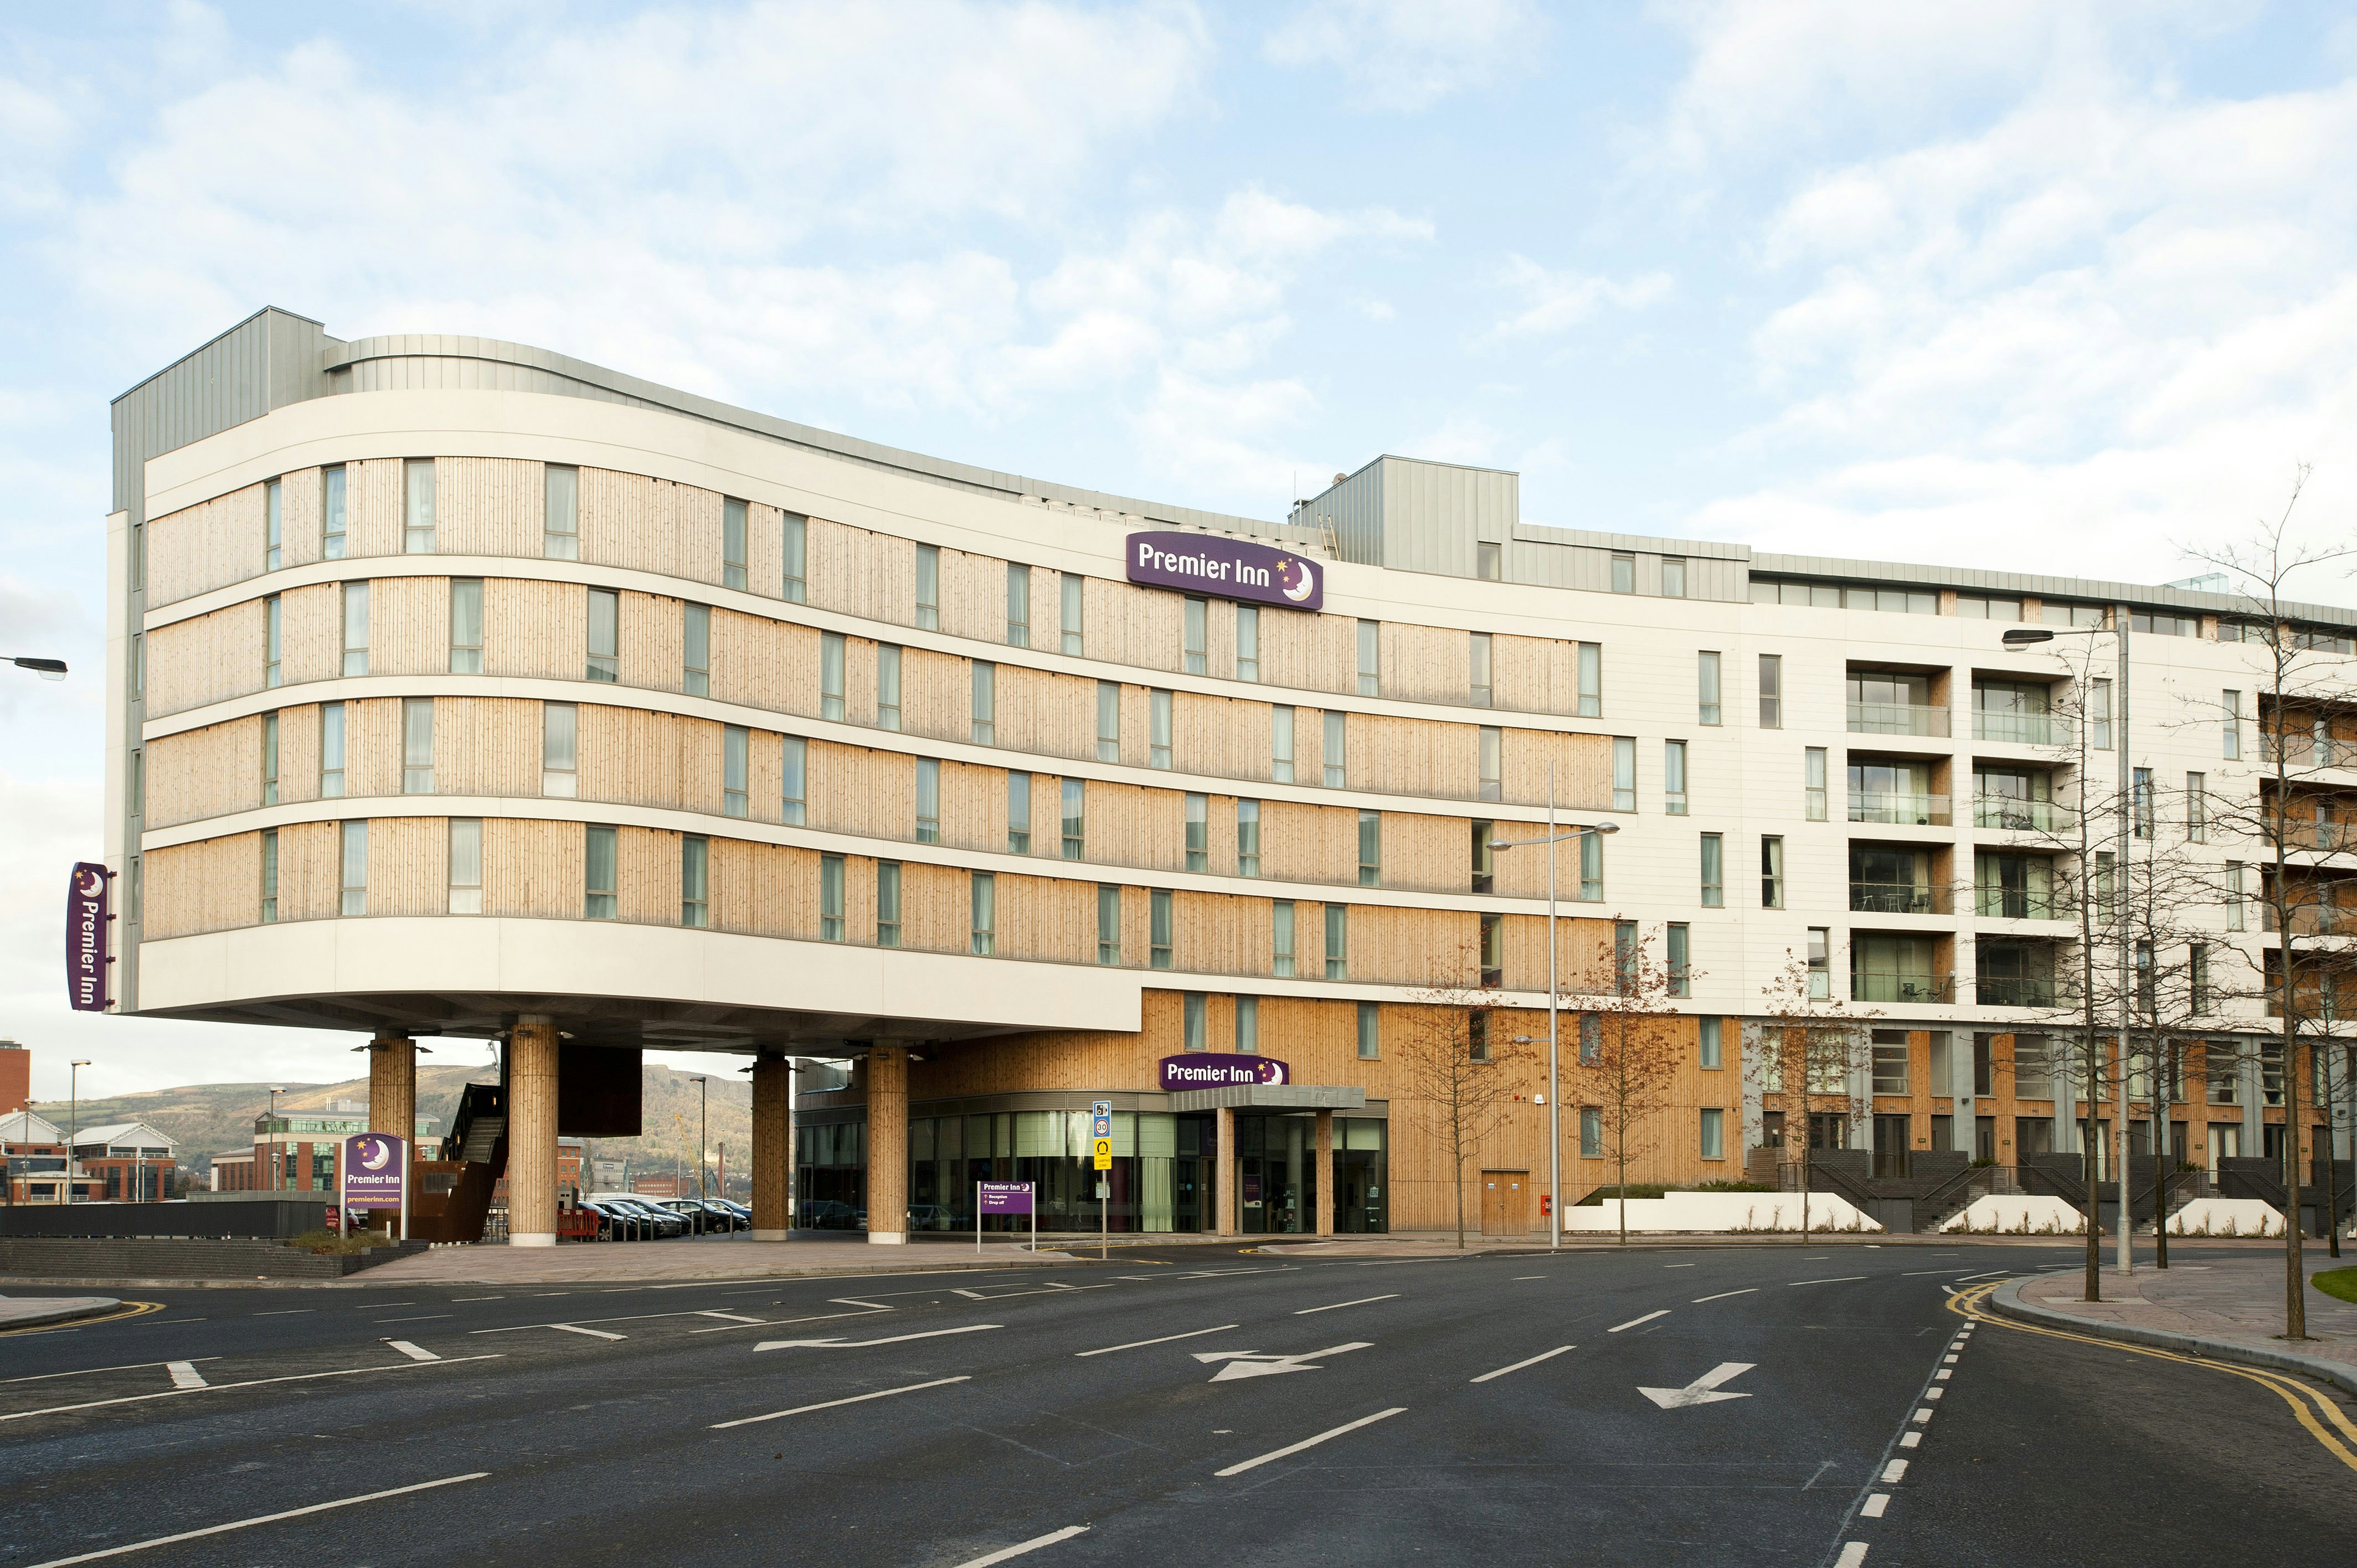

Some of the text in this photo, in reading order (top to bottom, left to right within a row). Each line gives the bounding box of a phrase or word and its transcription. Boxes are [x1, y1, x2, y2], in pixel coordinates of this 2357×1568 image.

[1139, 543, 1270, 587] Premier Inn
[81, 900, 99, 1004] Premier Inn
[1167, 1063, 1254, 1082] Premier Inn
[348, 1174, 400, 1184] Premier Inn
